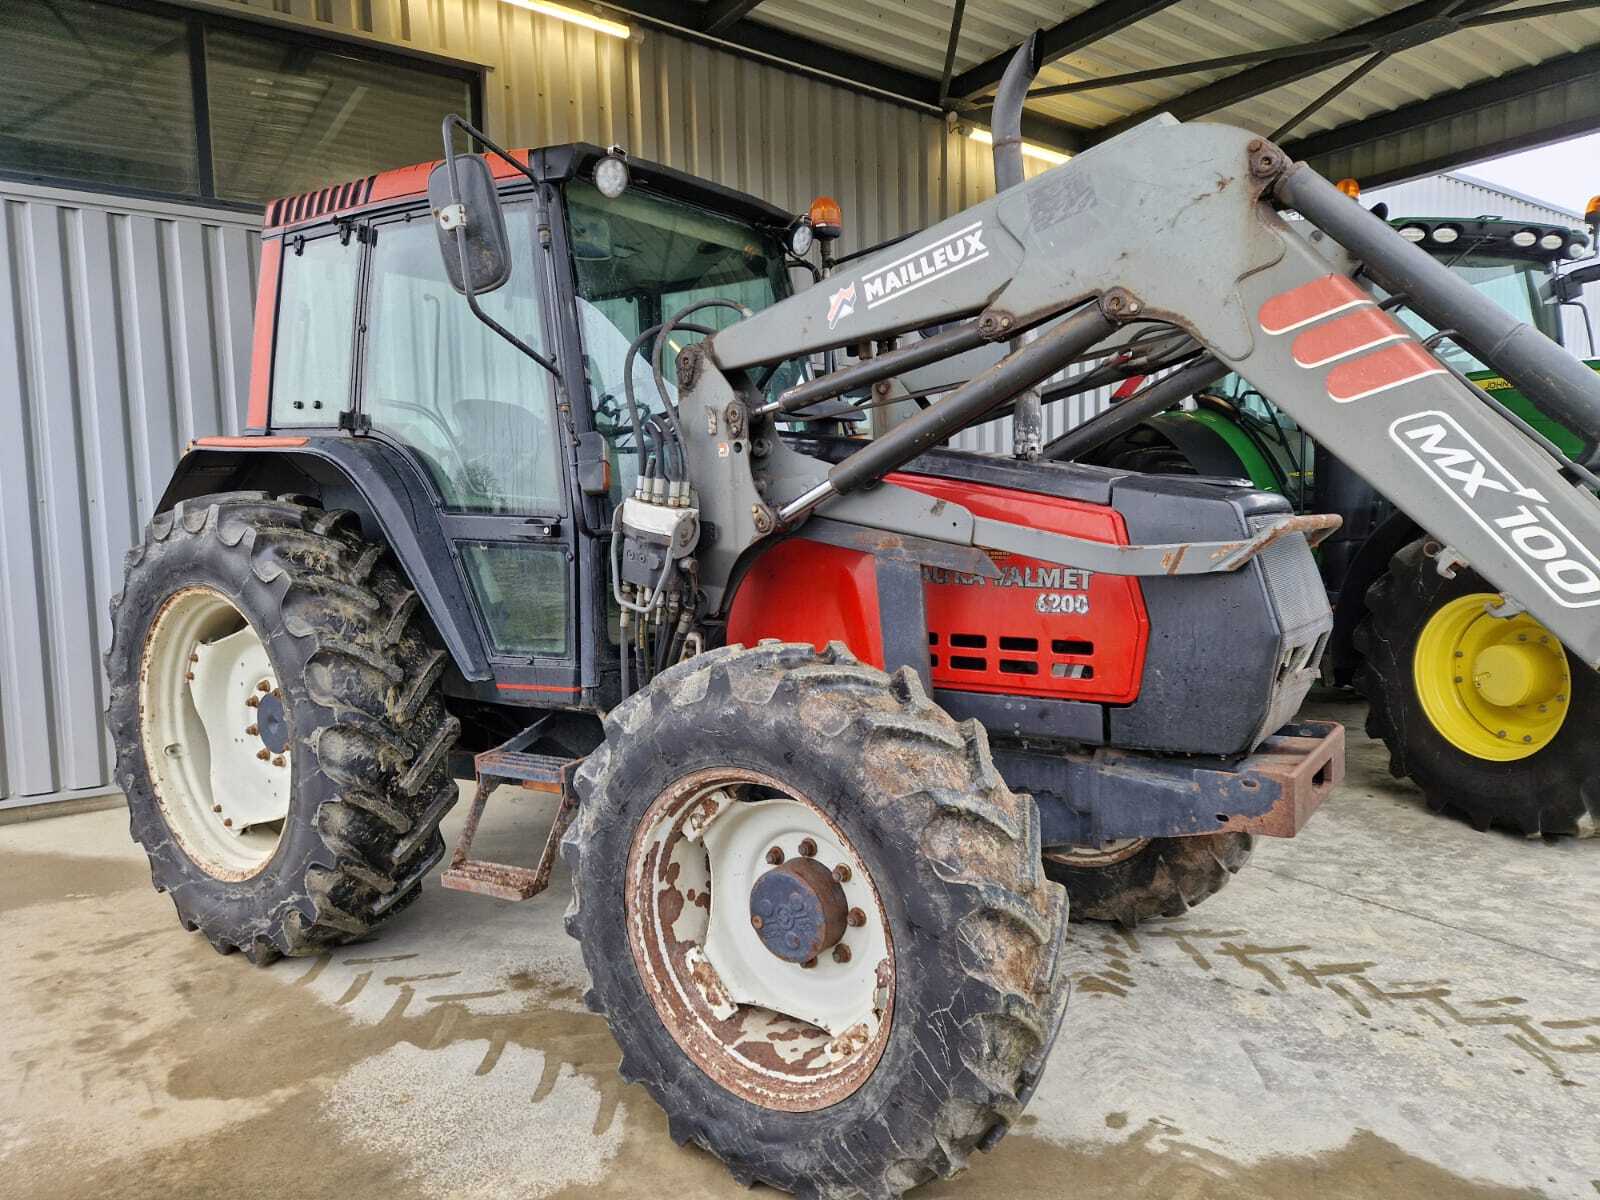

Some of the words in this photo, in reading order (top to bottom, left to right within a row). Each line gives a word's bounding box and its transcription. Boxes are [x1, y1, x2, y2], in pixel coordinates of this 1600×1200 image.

[864, 229, 987, 301] MAILLEUX
[1404, 423, 1510, 499] MX
[1493, 504, 1600, 594] 100
